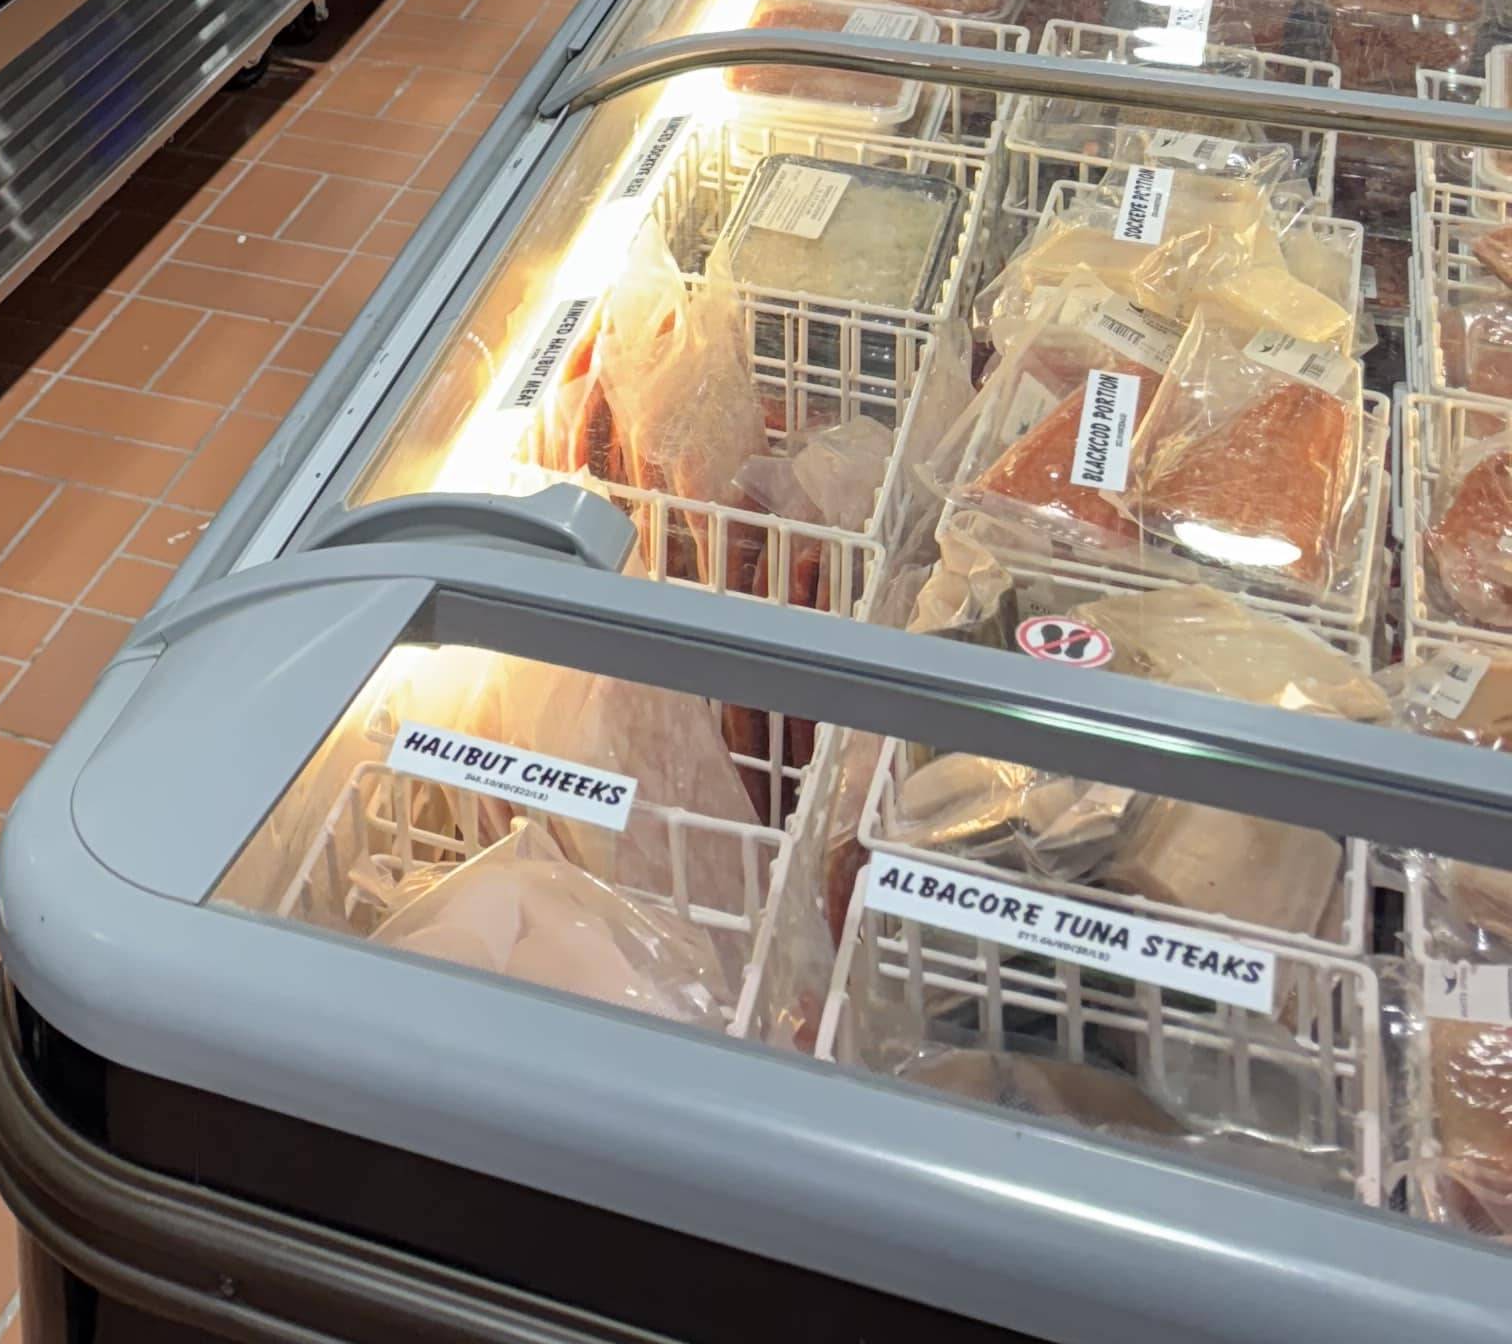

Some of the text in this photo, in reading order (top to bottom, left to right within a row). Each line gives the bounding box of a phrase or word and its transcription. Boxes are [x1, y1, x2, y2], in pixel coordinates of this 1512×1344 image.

[1123, 201, 1148, 240] SOCKEYE
[514, 299, 589, 407] MINCED HALIBUT MEAT
[1082, 373, 1119, 483] BLACKCOD PORTION
[404, 730, 628, 806] HALIBUT CHEEKS
[879, 867, 1265, 985] ALBACORE TUNA STEAKS
